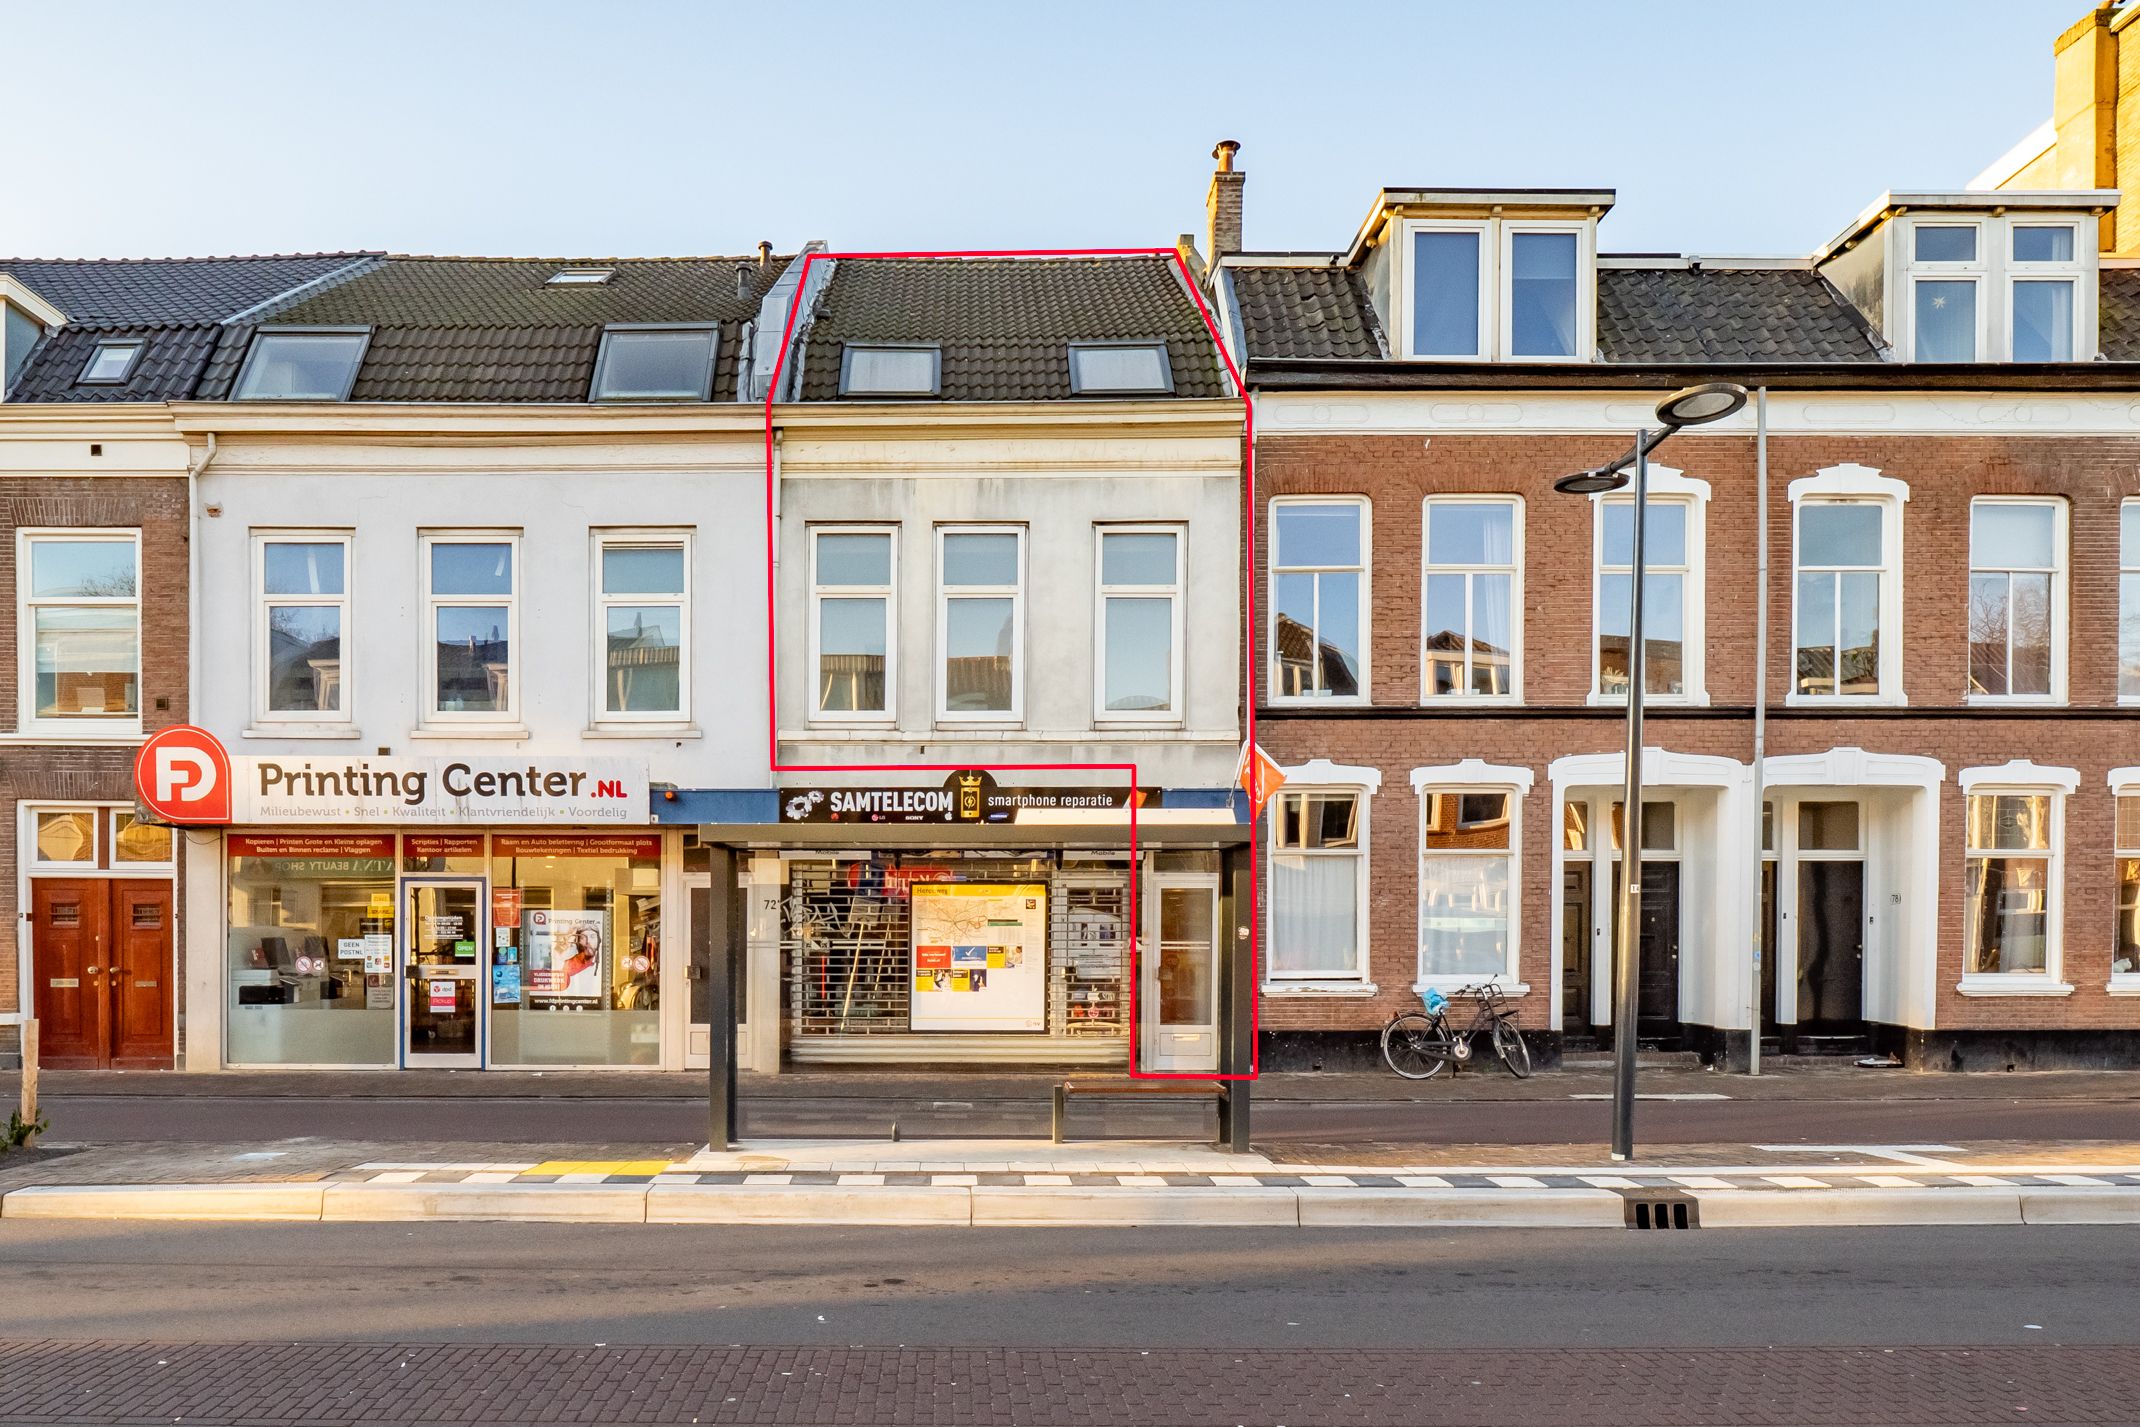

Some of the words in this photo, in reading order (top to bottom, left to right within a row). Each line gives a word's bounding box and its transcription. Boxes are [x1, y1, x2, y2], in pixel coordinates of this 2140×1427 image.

[257, 763, 428, 806] Printing
[830, 791, 954, 812] SAMTELECOM
[987, 793, 1057, 809] smartphone
[1060, 793, 1113, 809] reparatie
[259, 806, 341, 817] Milieubewust
[354, 806, 380, 817] Snel
[392, 806, 446, 817] Kwaliteit
[459, 806, 556, 820] Klantvriendelijk
[568, 806, 627, 819] Voordelig
[245, 838, 275, 847] Kopieren
[280, 838, 304, 846] Printen
[304, 838, 323, 846] Grote
[334, 838, 355, 846] Kleine
[356, 838, 383, 847] oplagen
[411, 838, 439, 846] Scripties
[444, 838, 478, 847] Rapporten
[501, 838, 520, 846] Raam
[531, 838, 547, 846] Auto
[548, 838, 585, 847] belettering
[589, 838, 635, 846] Grootformaat
[636, 839, 653, 848] plots
[256, 846, 278, 854] Buiten
[288, 846, 312, 854] Binnen
[312, 846, 340, 854] reclame
[344, 846, 371, 855] Vlaggen
[515, 846, 572, 855] Bouwtekeningen
[577, 846, 599, 854] Textiel
[599, 846, 638, 855] bedrukking
